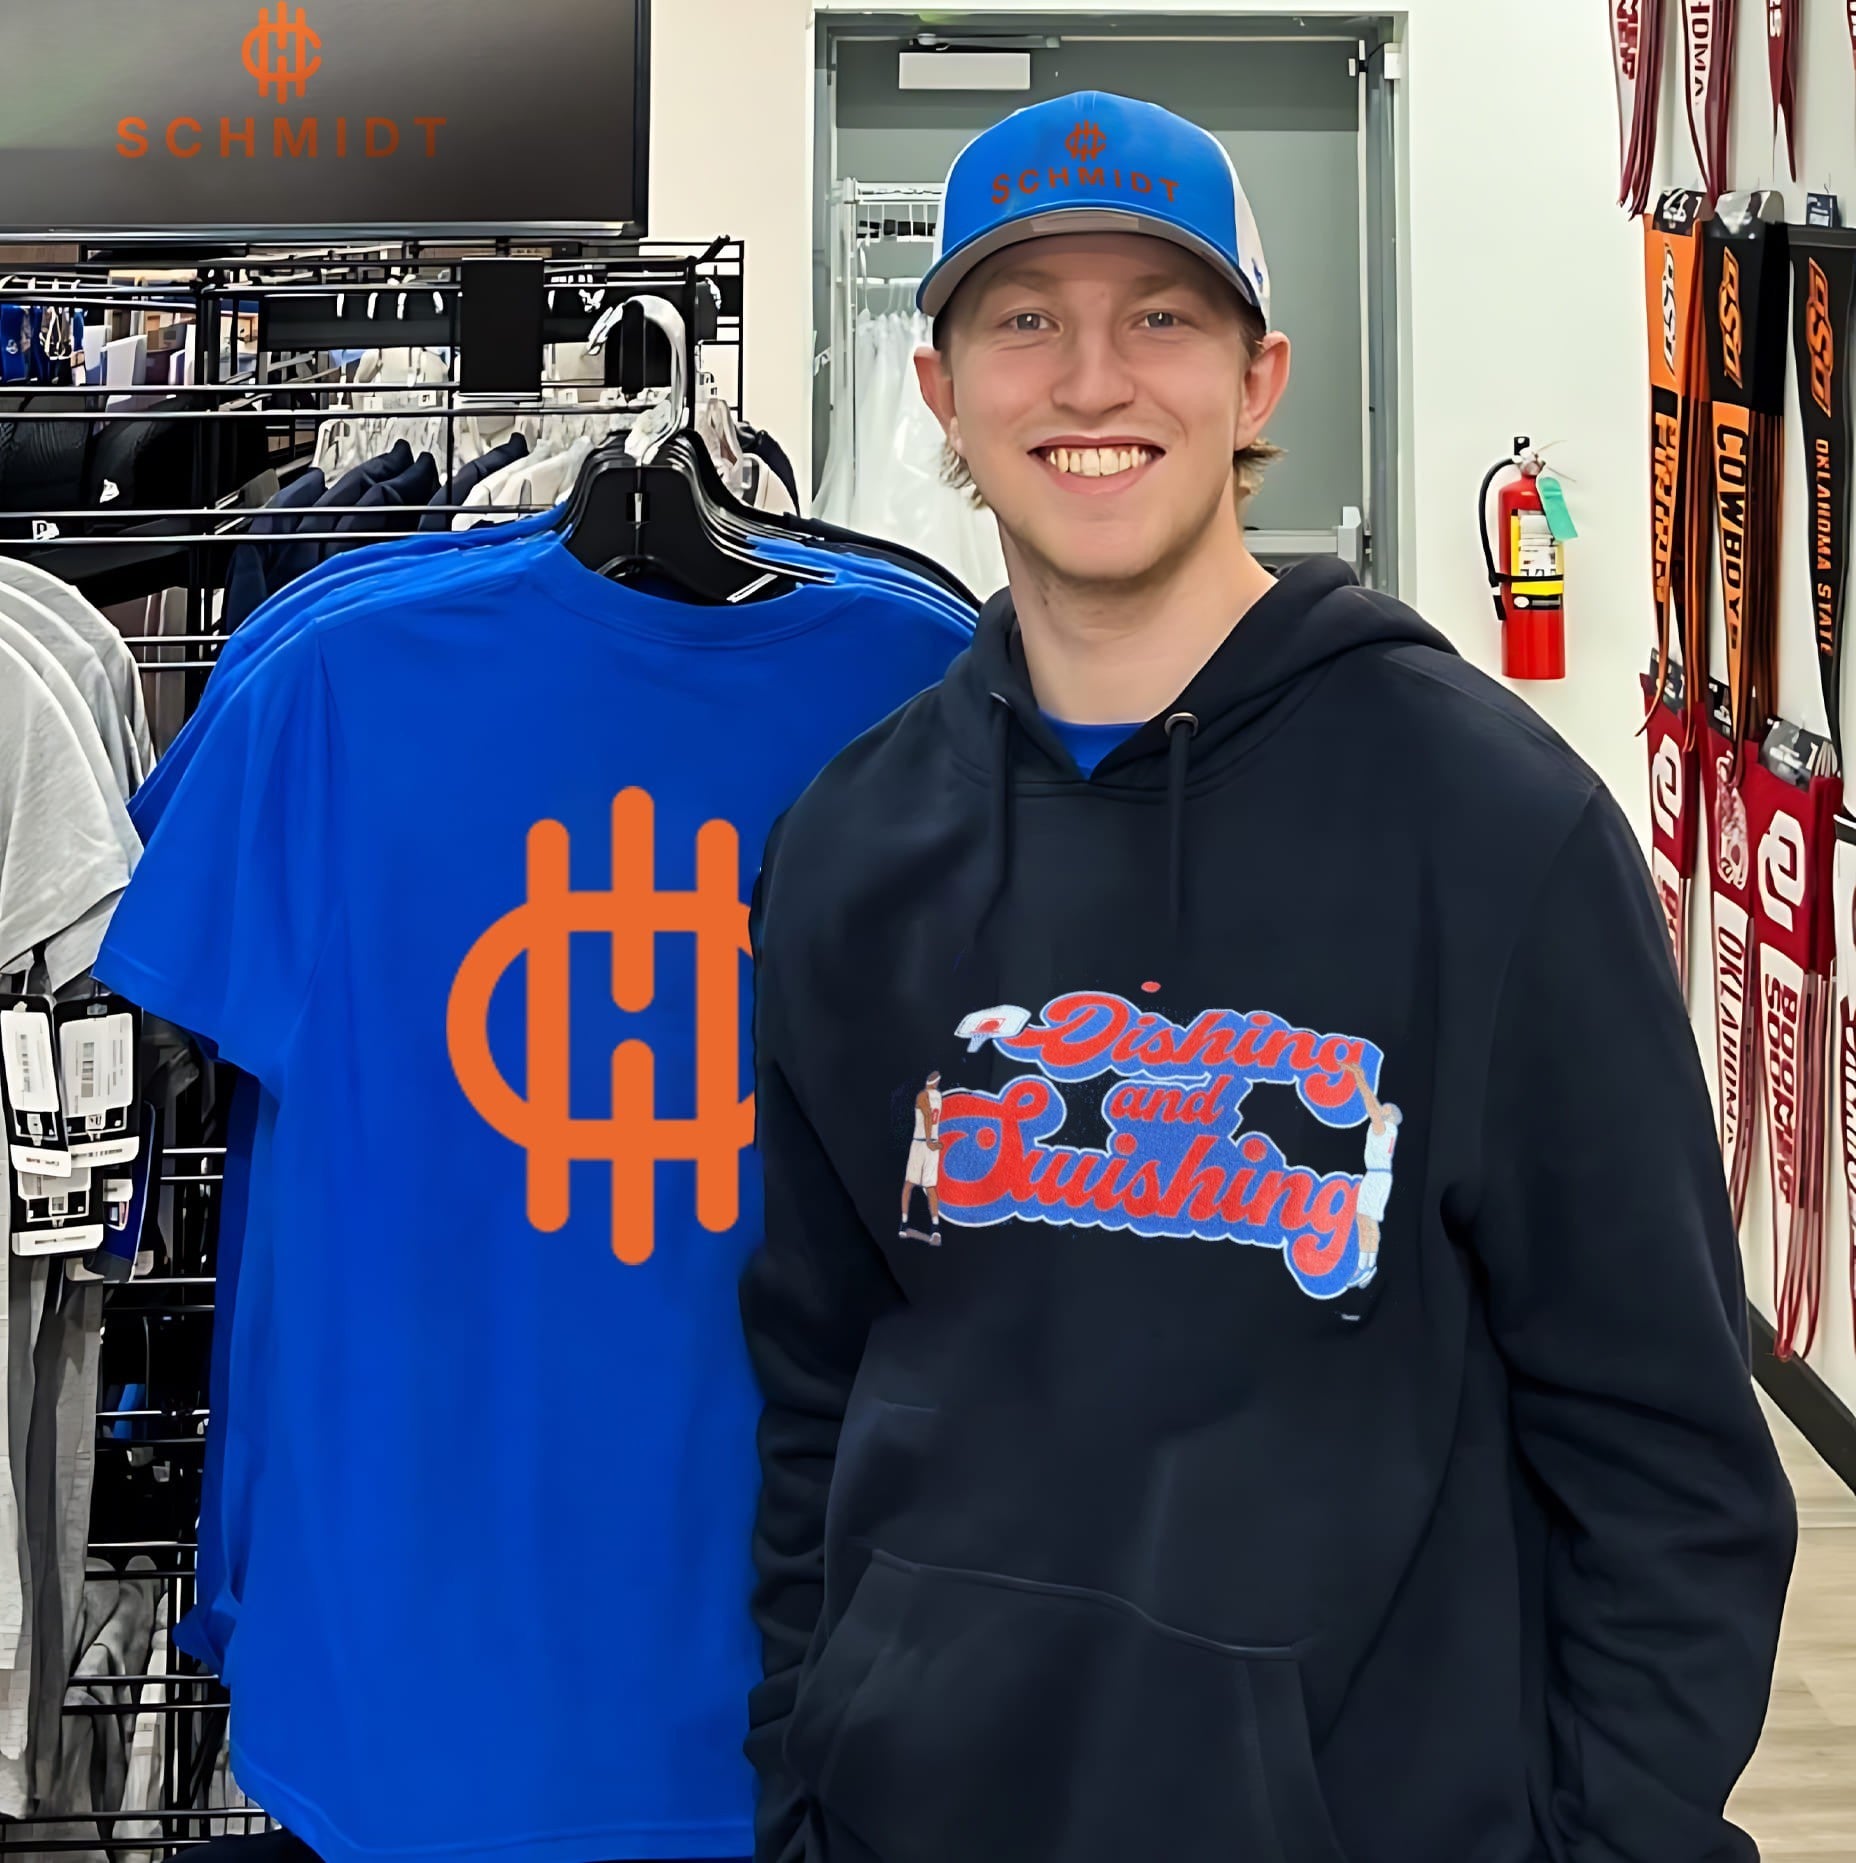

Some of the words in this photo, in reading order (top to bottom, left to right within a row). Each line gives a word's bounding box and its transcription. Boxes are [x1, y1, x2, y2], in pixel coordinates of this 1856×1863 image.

[116, 116, 447, 158] SCHMIDT
[991, 167, 1180, 205] SCHMIDT
[1002, 992, 1366, 1110] Dishing
[1108, 1074, 1234, 1125] and
[937, 1080, 1363, 1278] Swishing
